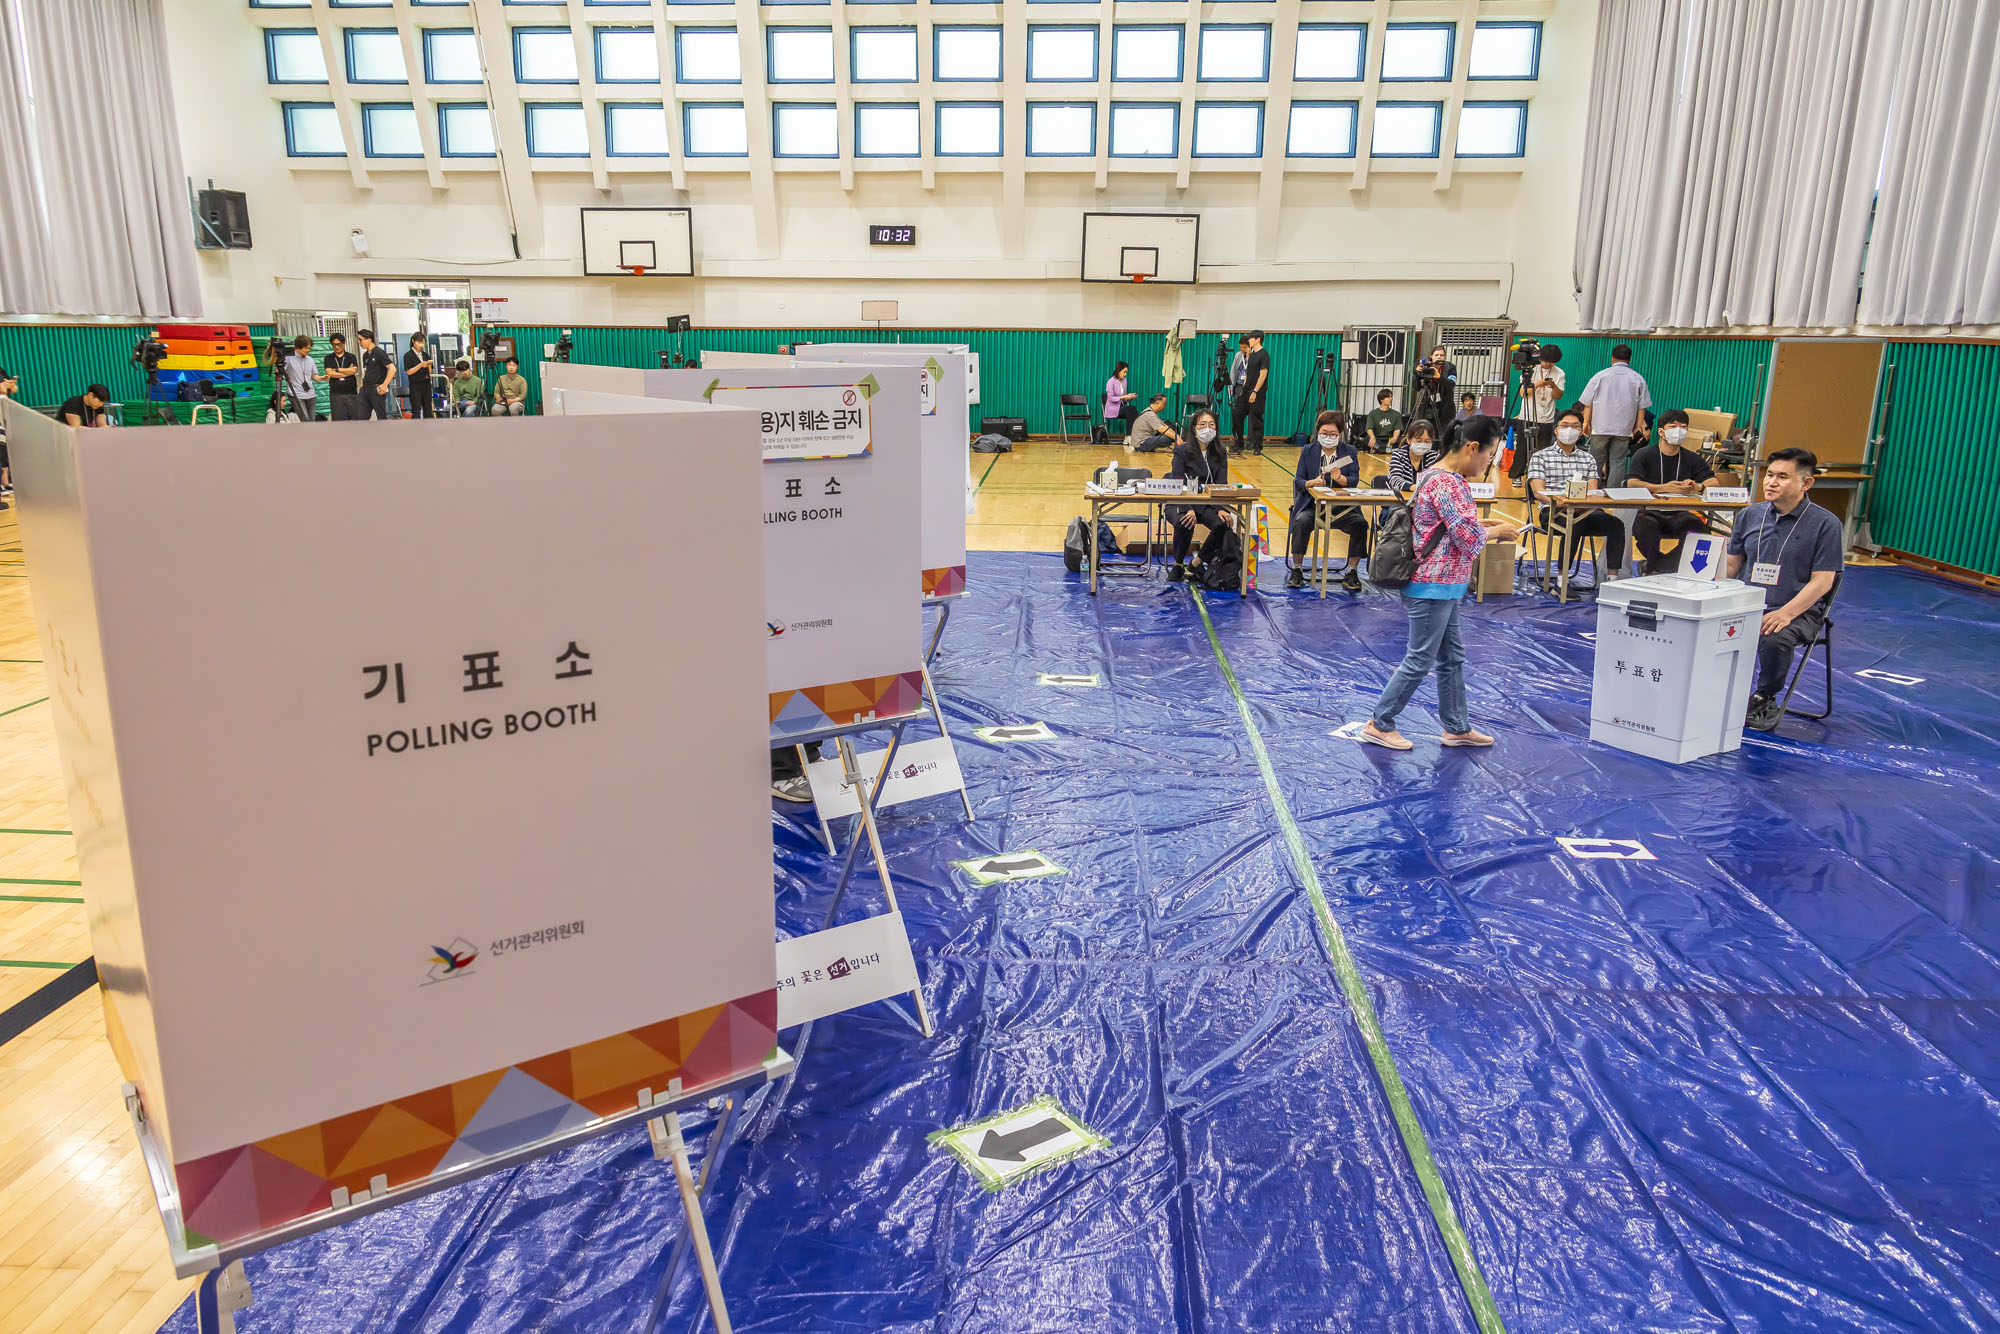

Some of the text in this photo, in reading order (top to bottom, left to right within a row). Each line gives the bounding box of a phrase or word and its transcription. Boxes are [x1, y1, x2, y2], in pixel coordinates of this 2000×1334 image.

[877, 229, 911, 242] 10:32
[798, 409, 830, 432] 훼손
[832, 408, 863, 430] 금지
[785, 476, 842, 498] 표 소
[801, 507, 843, 521] BOOTH
[790, 618, 833, 632] 선거관리위원회
[362, 641, 593, 704] 기 표 소
[367, 701, 597, 757] POLLING BOOTH
[489, 919, 585, 957] 선거관리위원회
[800, 968, 824, 985] 꽃은
